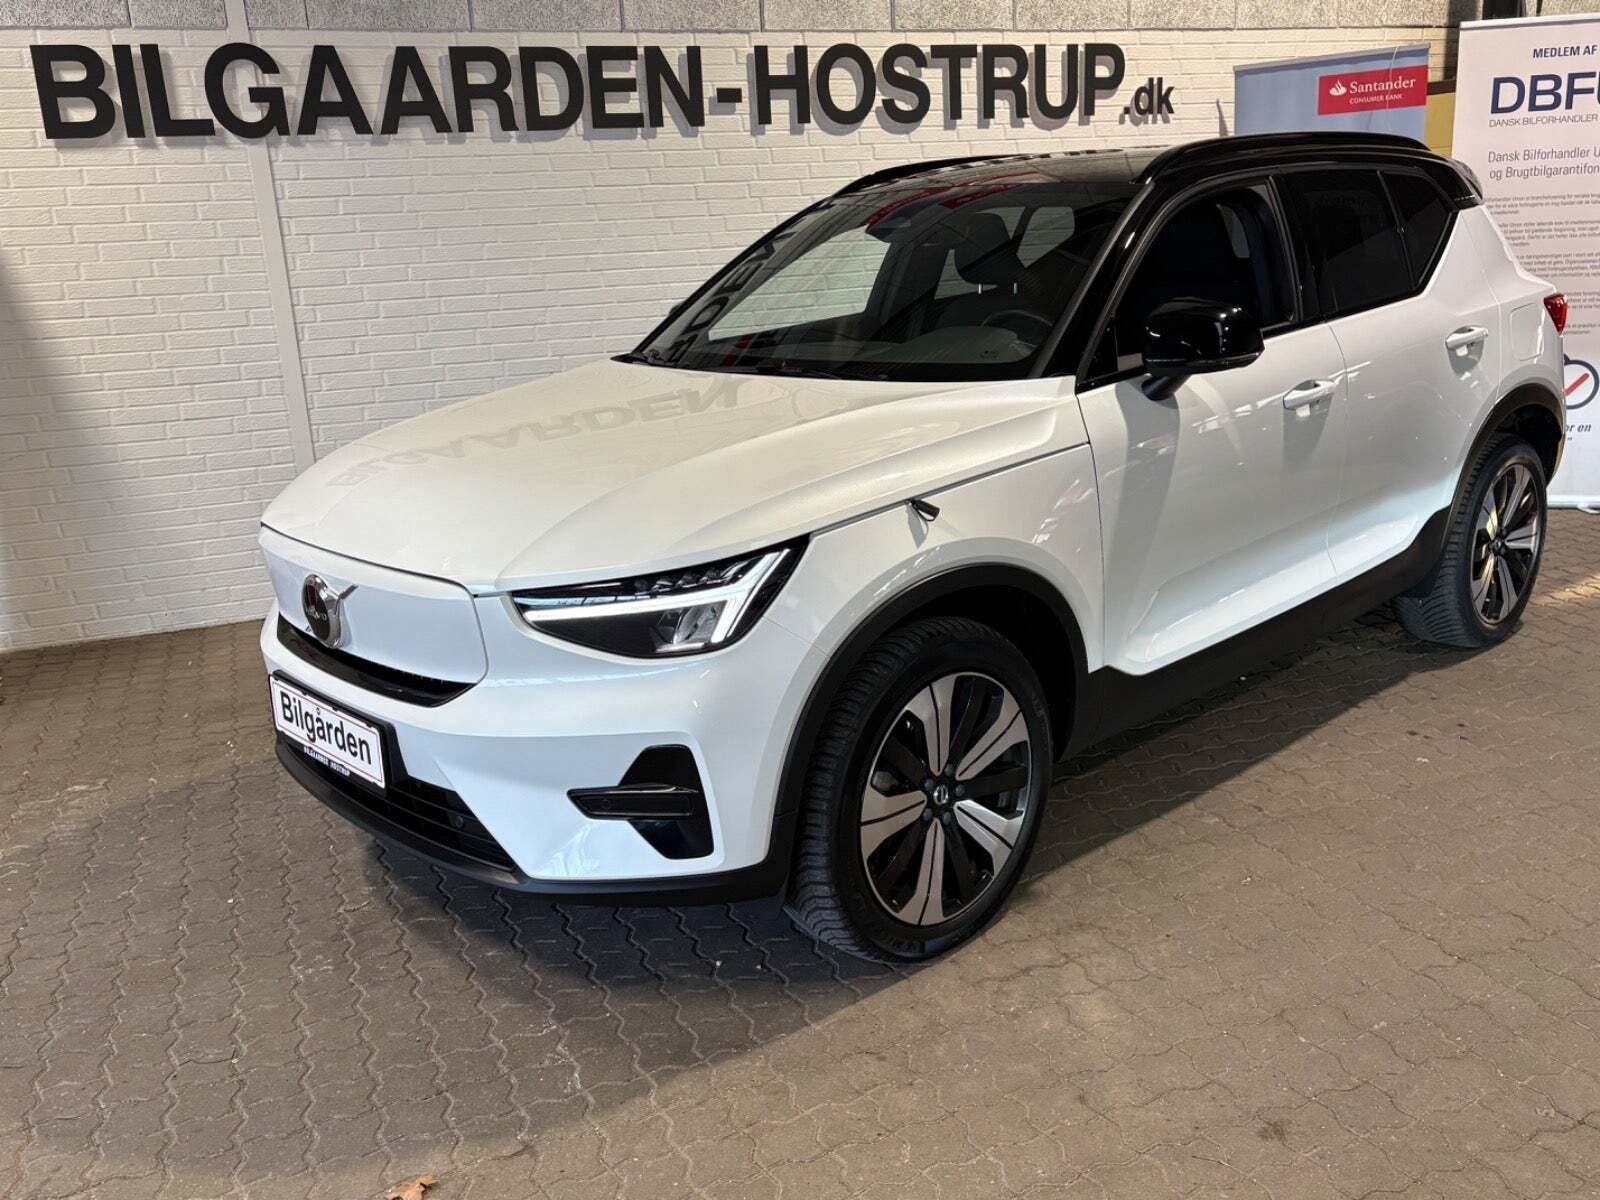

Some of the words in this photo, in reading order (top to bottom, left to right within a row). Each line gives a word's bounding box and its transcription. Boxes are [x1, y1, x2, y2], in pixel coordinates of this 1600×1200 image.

[1533, 46, 1580, 58] MEDLEM
[1583, 45, 1598, 56] AF
[1349, 76, 1417, 94] Santander
[1349, 95, 1384, 105] CONSUMER
[1386, 93, 1402, 101] BANK
[1490, 72, 1600, 115] DBF
[1489, 118, 1521, 128] DANSK
[1522, 114, 1599, 126] BILFORHANDLER
[1488, 150, 1520, 163] Dansk
[1523, 147, 1590, 161] Bilforhandler
[1490, 169, 1502, 180] og
[1577, 423, 1592, 432] en
[279, 690, 372, 765] Bilgården
